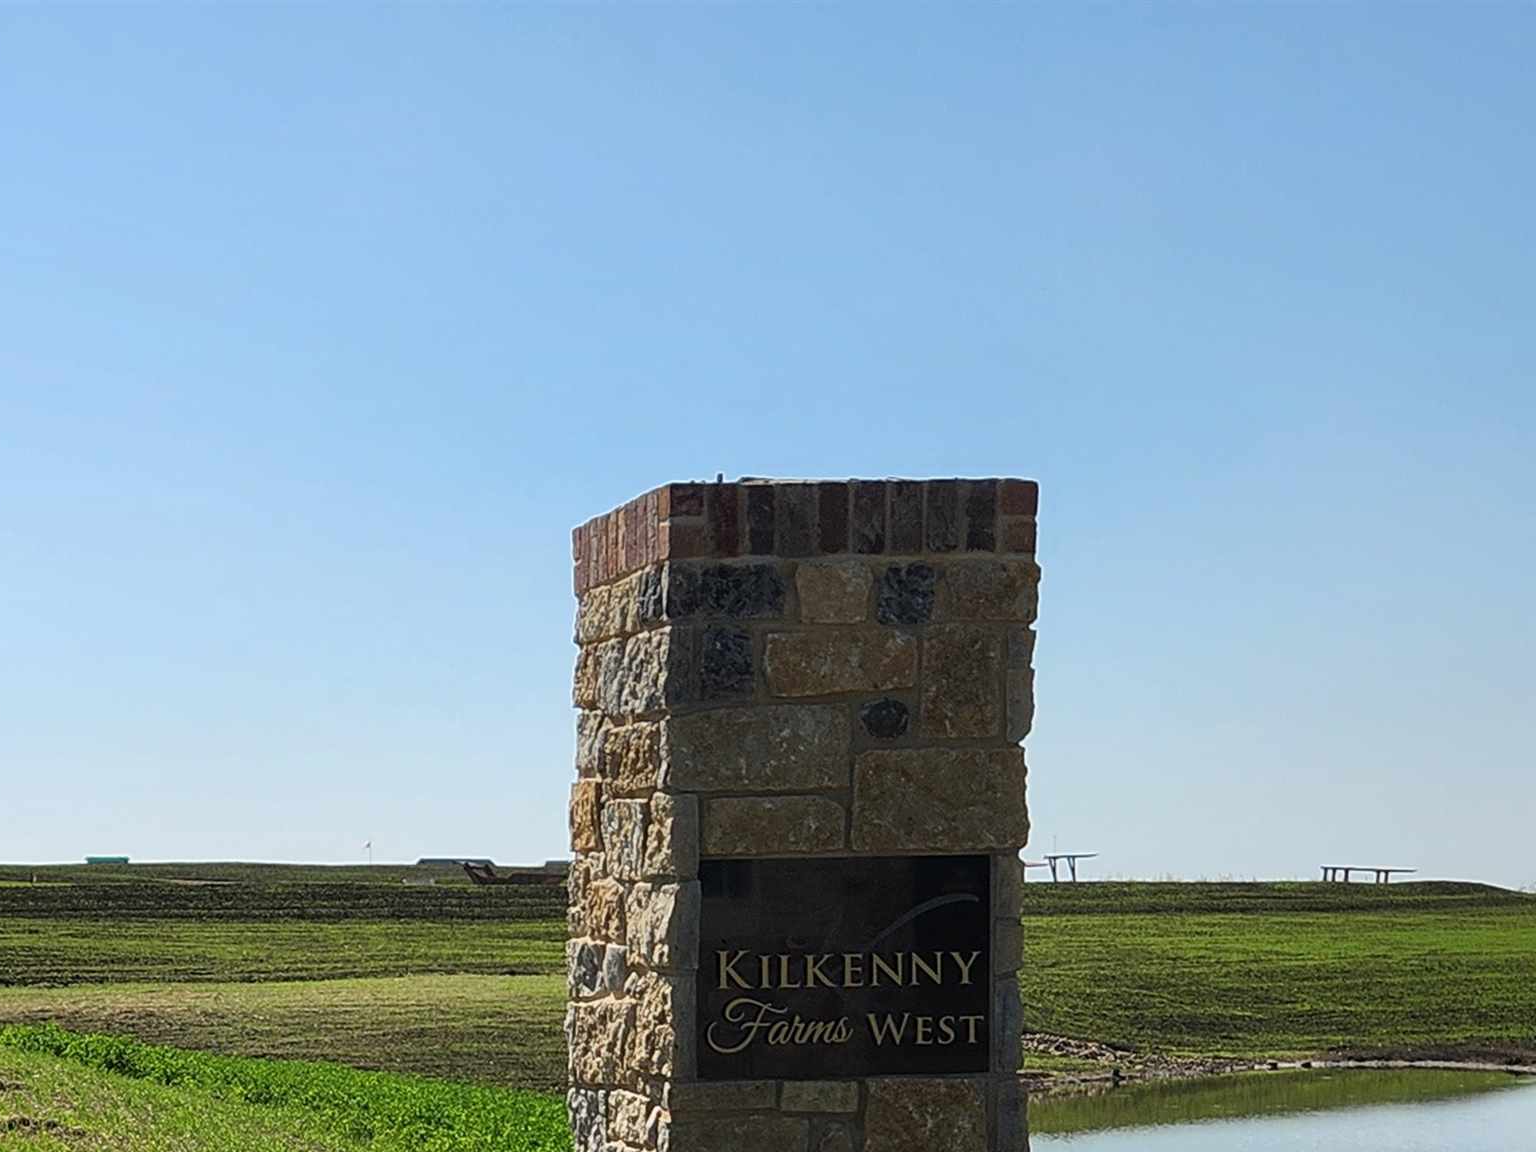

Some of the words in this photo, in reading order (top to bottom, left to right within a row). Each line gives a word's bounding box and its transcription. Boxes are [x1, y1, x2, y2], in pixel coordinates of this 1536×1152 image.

[716, 950, 982, 989] KILKENNY
[707, 998, 853, 1053] Farms
[867, 1012, 985, 1045] WEST
